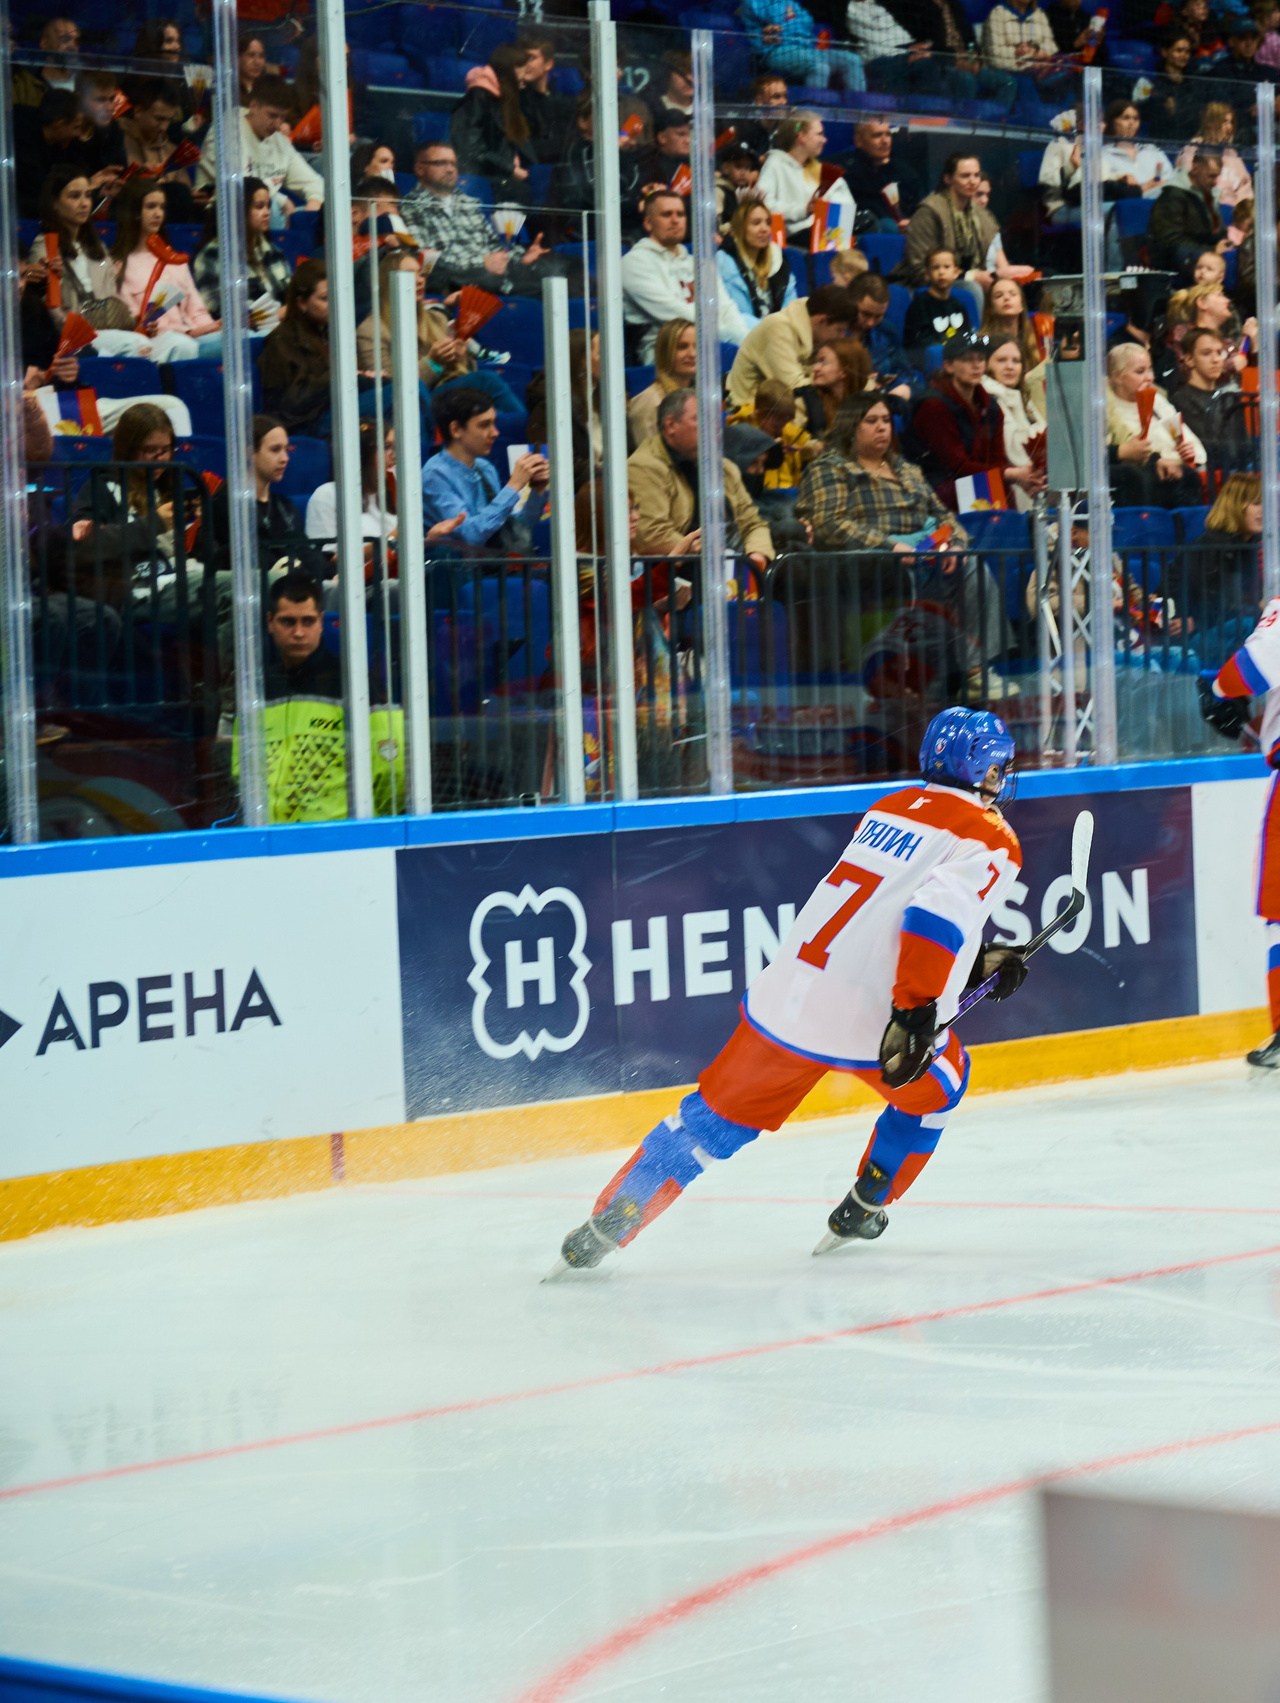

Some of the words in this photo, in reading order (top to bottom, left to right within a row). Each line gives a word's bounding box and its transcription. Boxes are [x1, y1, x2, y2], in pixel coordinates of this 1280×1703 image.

[611, 868, 1151, 1006] HENSON
[796, 860, 885, 971] 7
[34, 966, 283, 1057] АРЕНА
[504, 936, 556, 1009] H
